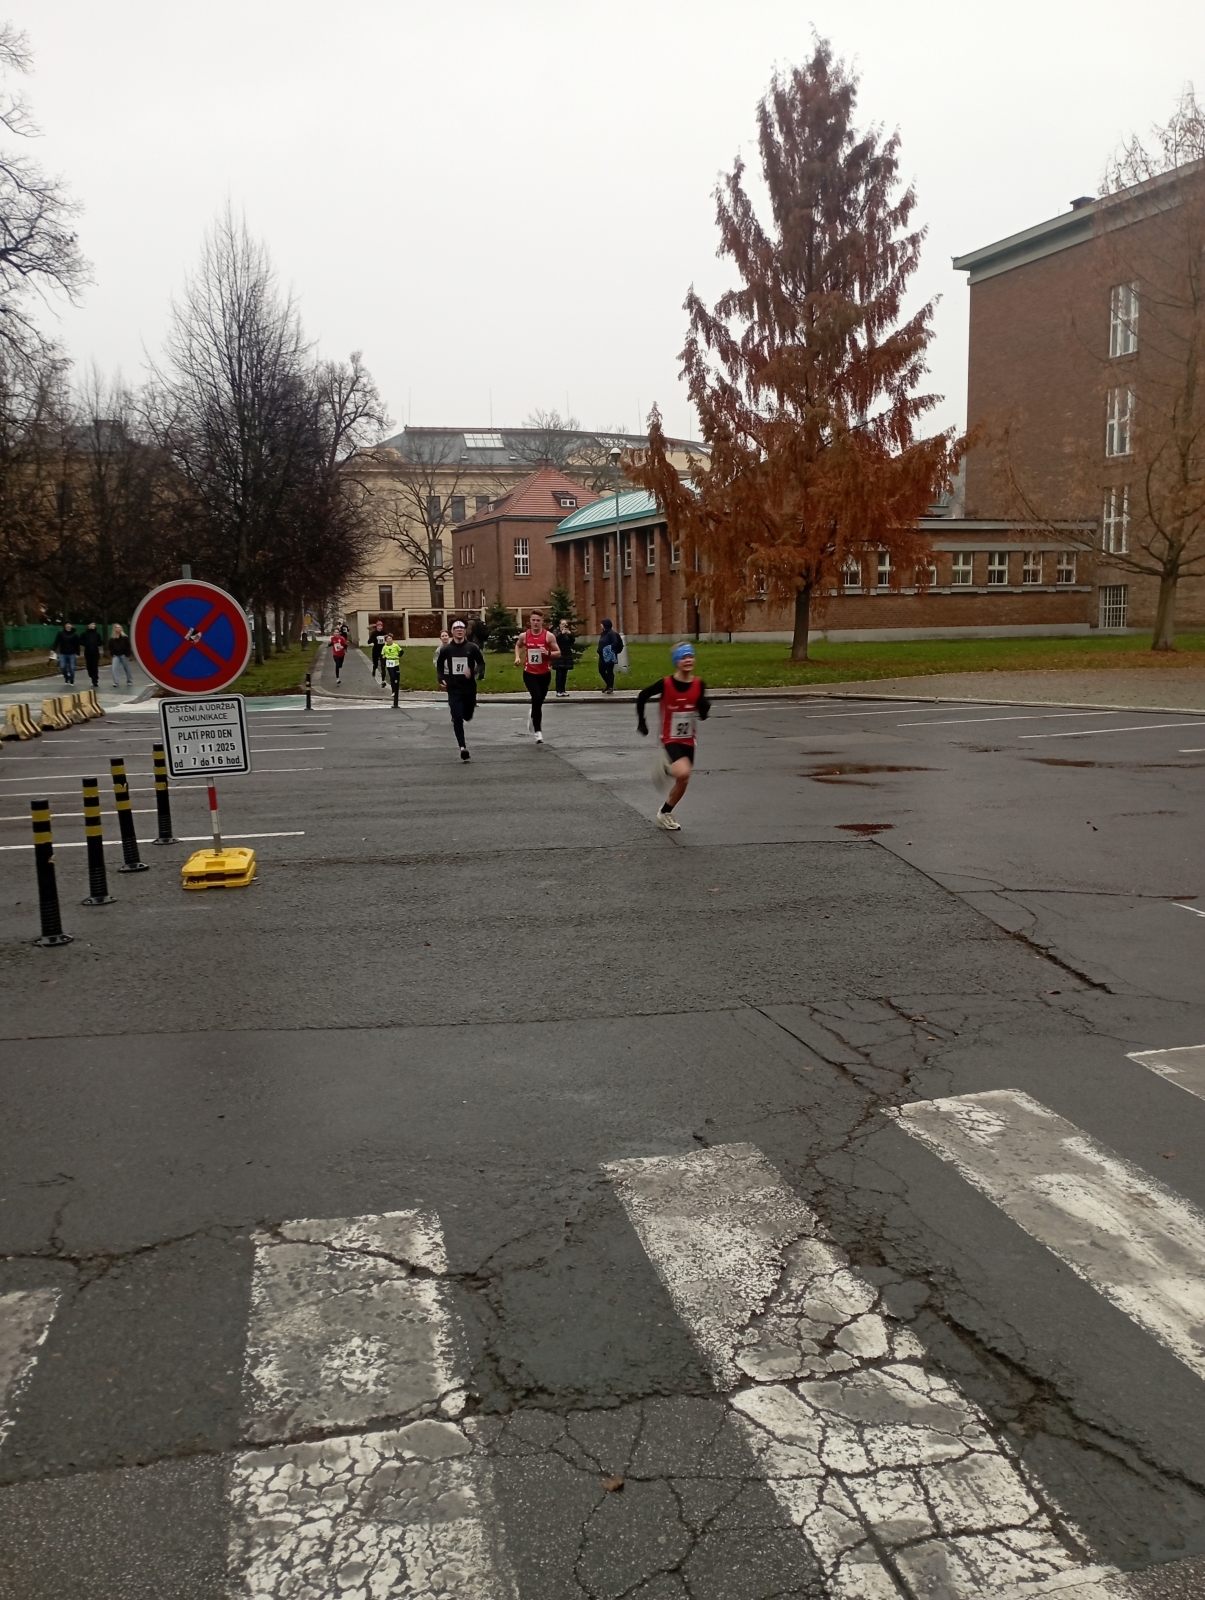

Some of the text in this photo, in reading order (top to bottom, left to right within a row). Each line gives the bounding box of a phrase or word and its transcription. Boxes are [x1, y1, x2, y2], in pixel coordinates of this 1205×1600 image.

[168, 704, 197, 713] ČIŠTĚNÍ
[205, 702, 236, 711] ÚDRŽBA
[178, 713, 228, 722] KOMUNIKACE
[178, 729, 233, 741] PLATÍ PRO DEN
[174, 759, 184, 768] od
[200, 758, 210, 767] do
[210, 755, 223, 764] 16
